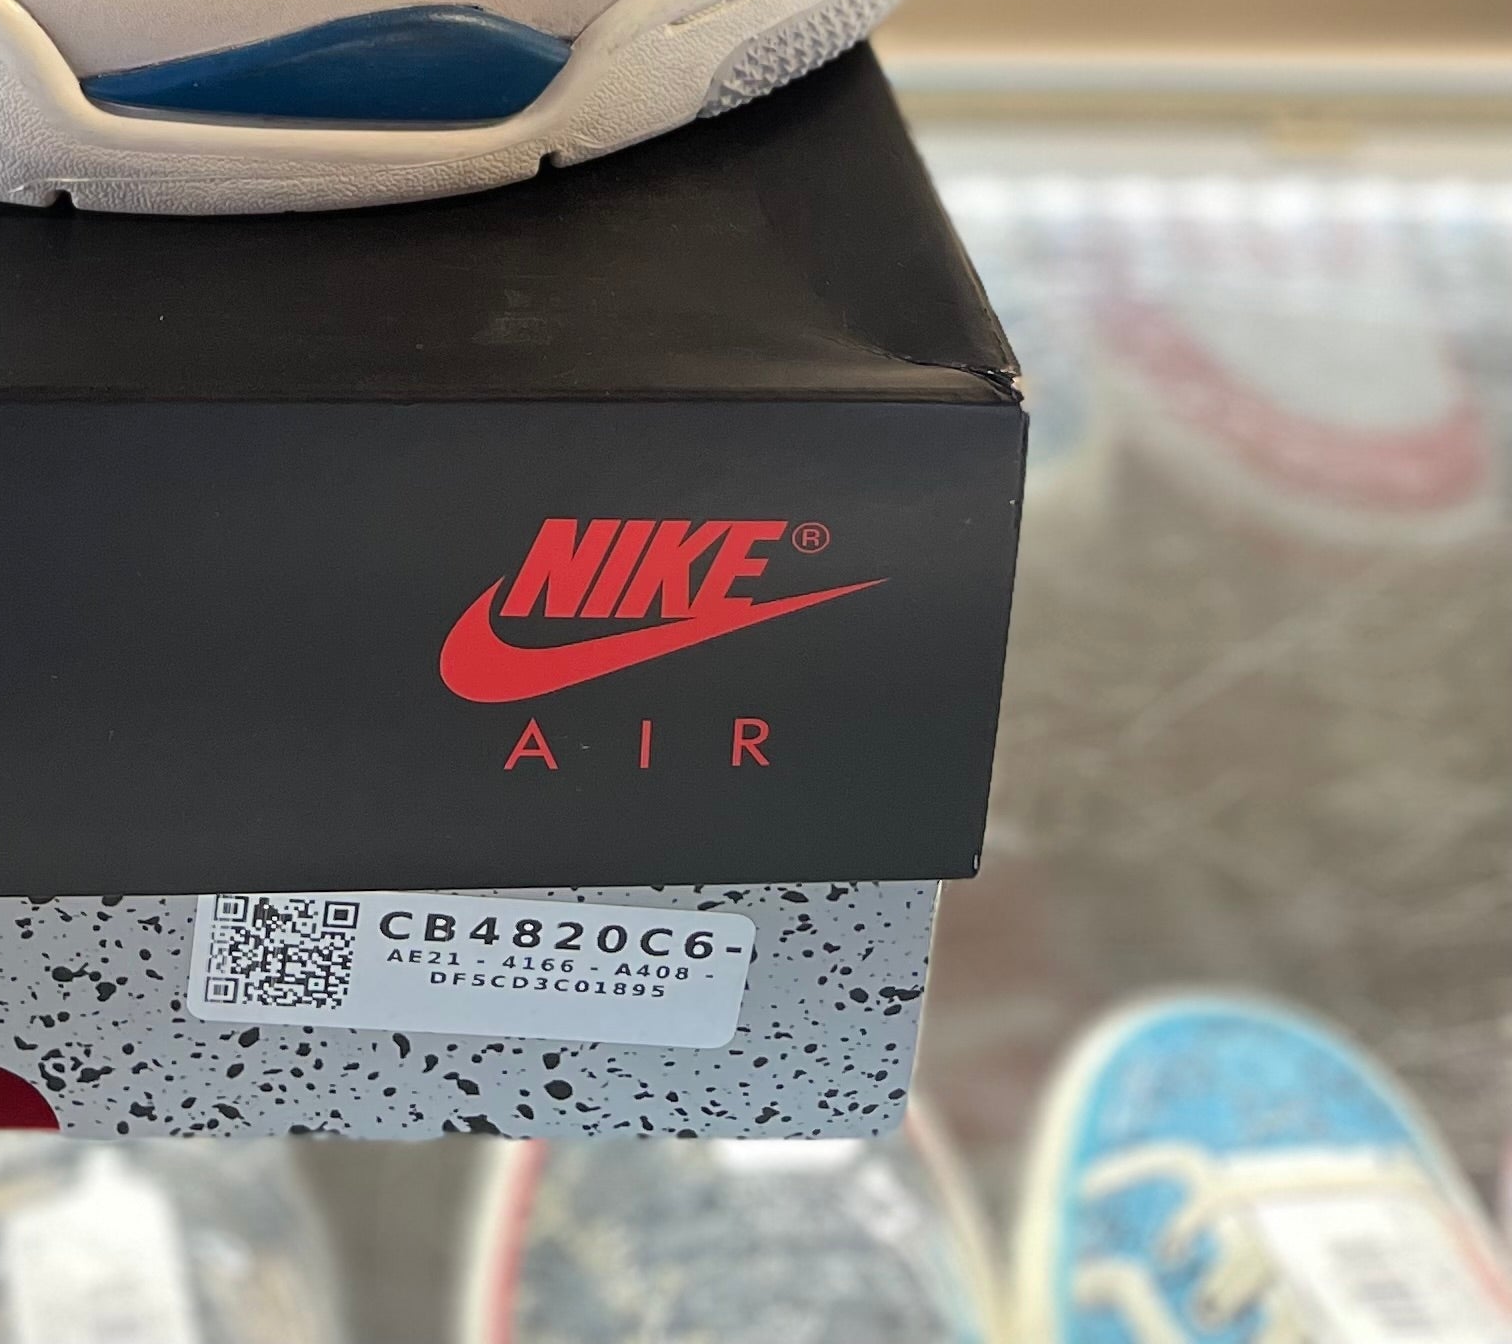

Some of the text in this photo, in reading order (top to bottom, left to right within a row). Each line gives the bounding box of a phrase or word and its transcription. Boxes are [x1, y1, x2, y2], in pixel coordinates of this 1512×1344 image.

[502, 716, 771, 770] AIR
[379, 910, 743, 960] CB4820C6-
[386, 948, 461, 967] AE21
[502, 955, 575, 973] 4166
[614, 963, 690, 981] A408
[429, 971, 666, 998] DF5CD3C01895
